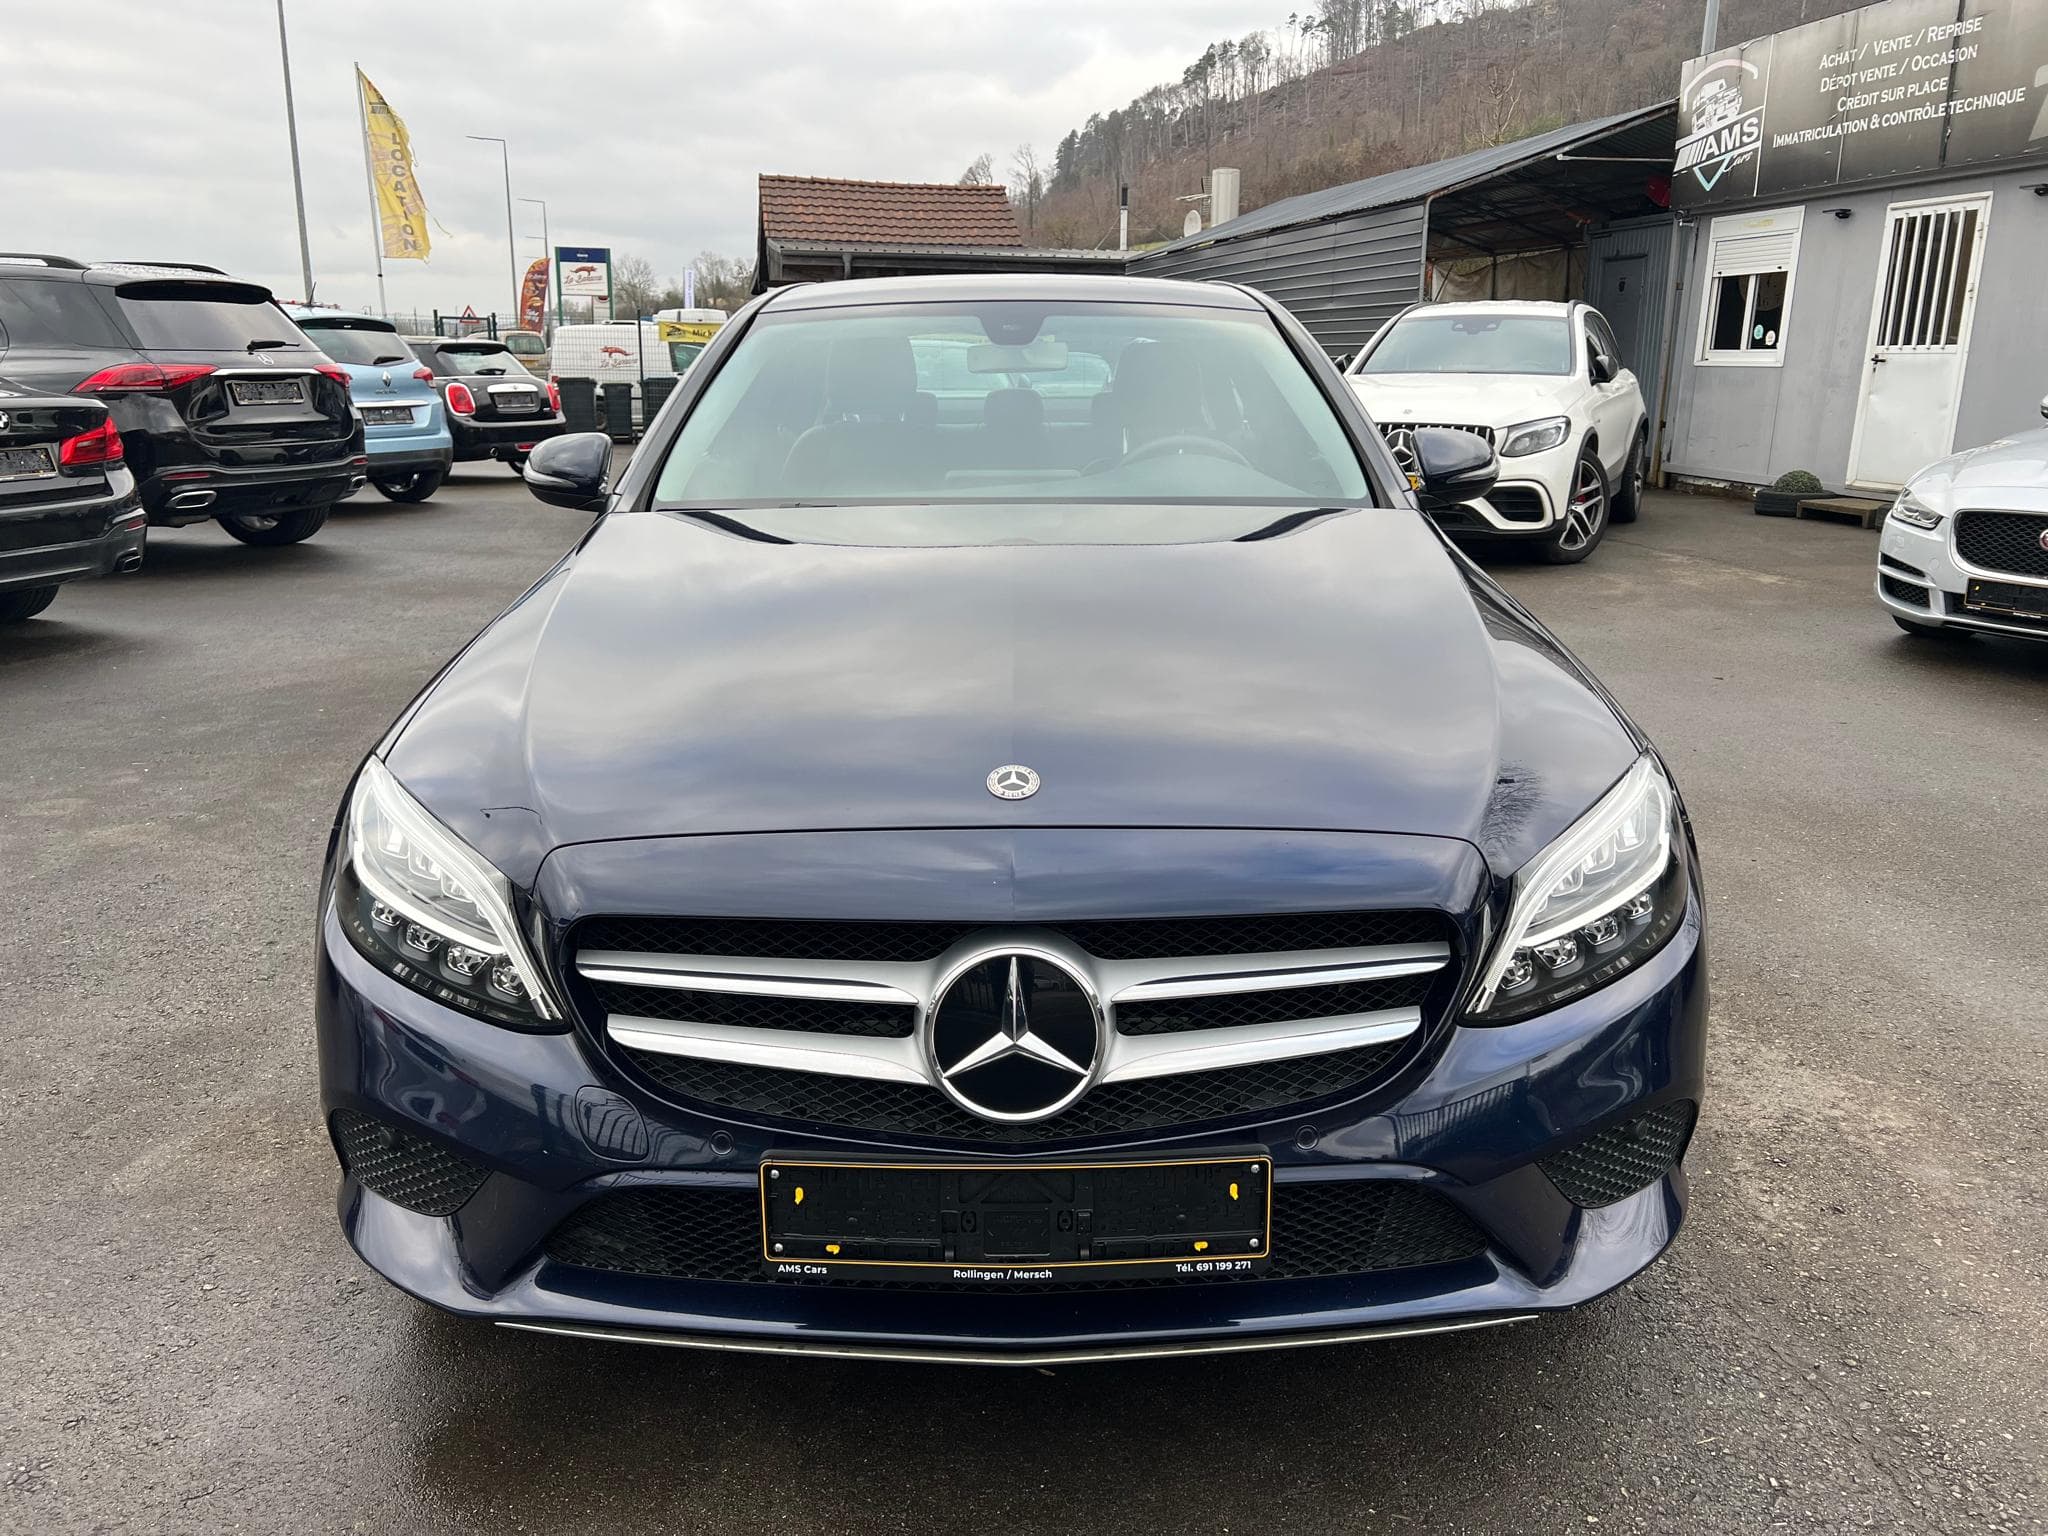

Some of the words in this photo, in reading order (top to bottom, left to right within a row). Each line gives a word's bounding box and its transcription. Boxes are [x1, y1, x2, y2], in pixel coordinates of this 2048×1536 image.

[1819, 48, 1857, 69] ACHAT
[1858, 43, 1868, 60] /
[1874, 34, 1912, 56] VENTE
[1915, 29, 1925, 46] /
[1927, 17, 1983, 43] REPRISE
[1860, 63, 1897, 83] VENTE
[1899, 57, 1909, 74] /
[1911, 44, 1979, 71] OCCASION
[1837, 92, 1879, 112] CRÉDIT
[1880, 86, 1905, 103] SUR
[1906, 77, 1949, 98] PLACE
[1772, 117, 1868, 149] IMMATRICULATION
[1870, 113, 1880, 129] &
[1881, 102, 1947, 127] CONTRÔLE
[1948, 87, 2027, 115] TECHNIQUE
[1701, 117, 1759, 161] AMS
[391, 132, 418, 251] LOCATION
[778, 1264, 802, 1273] AMS
[804, 1265, 828, 1274] Cars
[953, 1269, 1004, 1281] Rollingen
[1006, 1269, 1012, 1280] /
[1014, 1269, 1053, 1279] Mersch
[1176, 1263, 1194, 1273] Tél.
[1196, 1262, 1213, 1272] 691
[1215, 1261, 1233, 1271] 199
[1235, 1260, 1251, 1270] 271
